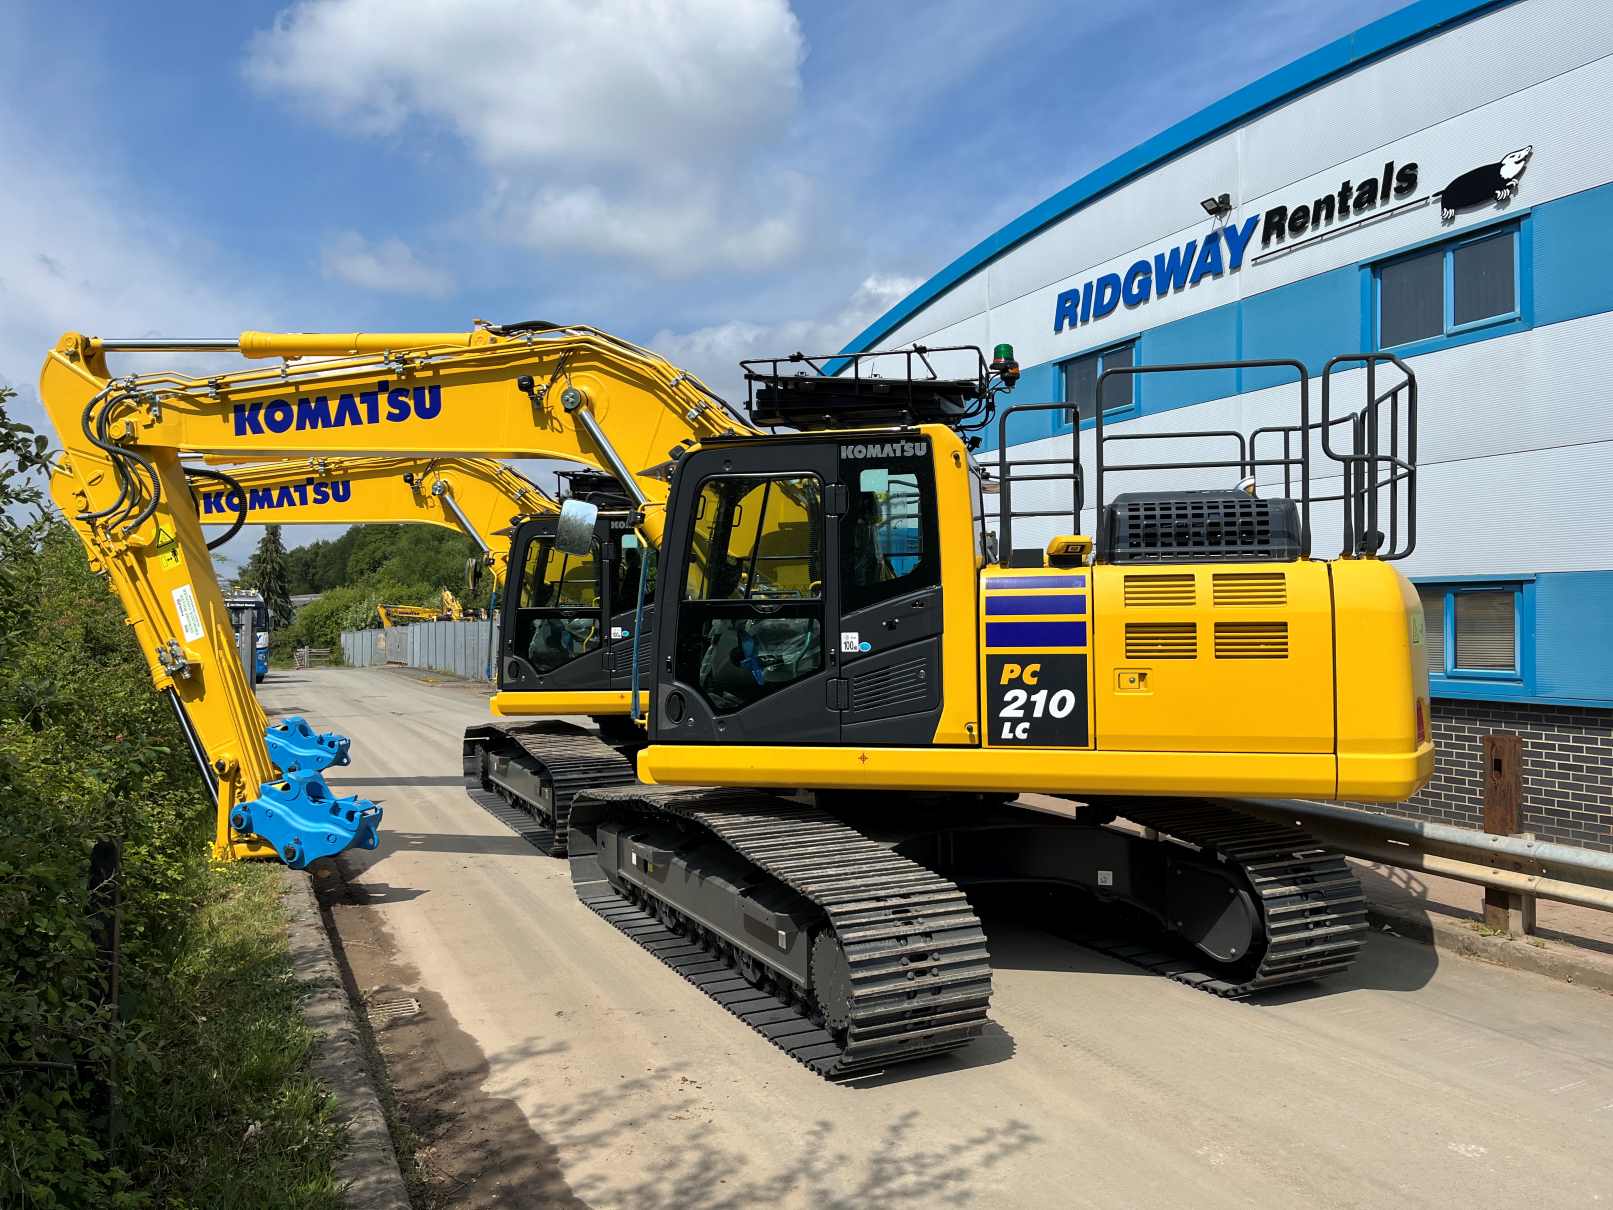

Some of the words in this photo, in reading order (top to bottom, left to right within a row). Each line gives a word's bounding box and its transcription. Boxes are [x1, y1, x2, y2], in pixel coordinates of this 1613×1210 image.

[1054, 214, 1260, 334] RIDGWAY
[1261, 160, 1419, 248] Rentals
[233, 380, 442, 437] KOMATSU
[841, 439, 927, 460] KOMATSU
[203, 477, 351, 515] KOMATSU
[1000, 663, 1041, 685] PC
[999, 688, 1076, 719] 210
[1001, 721, 1031, 739] LC
